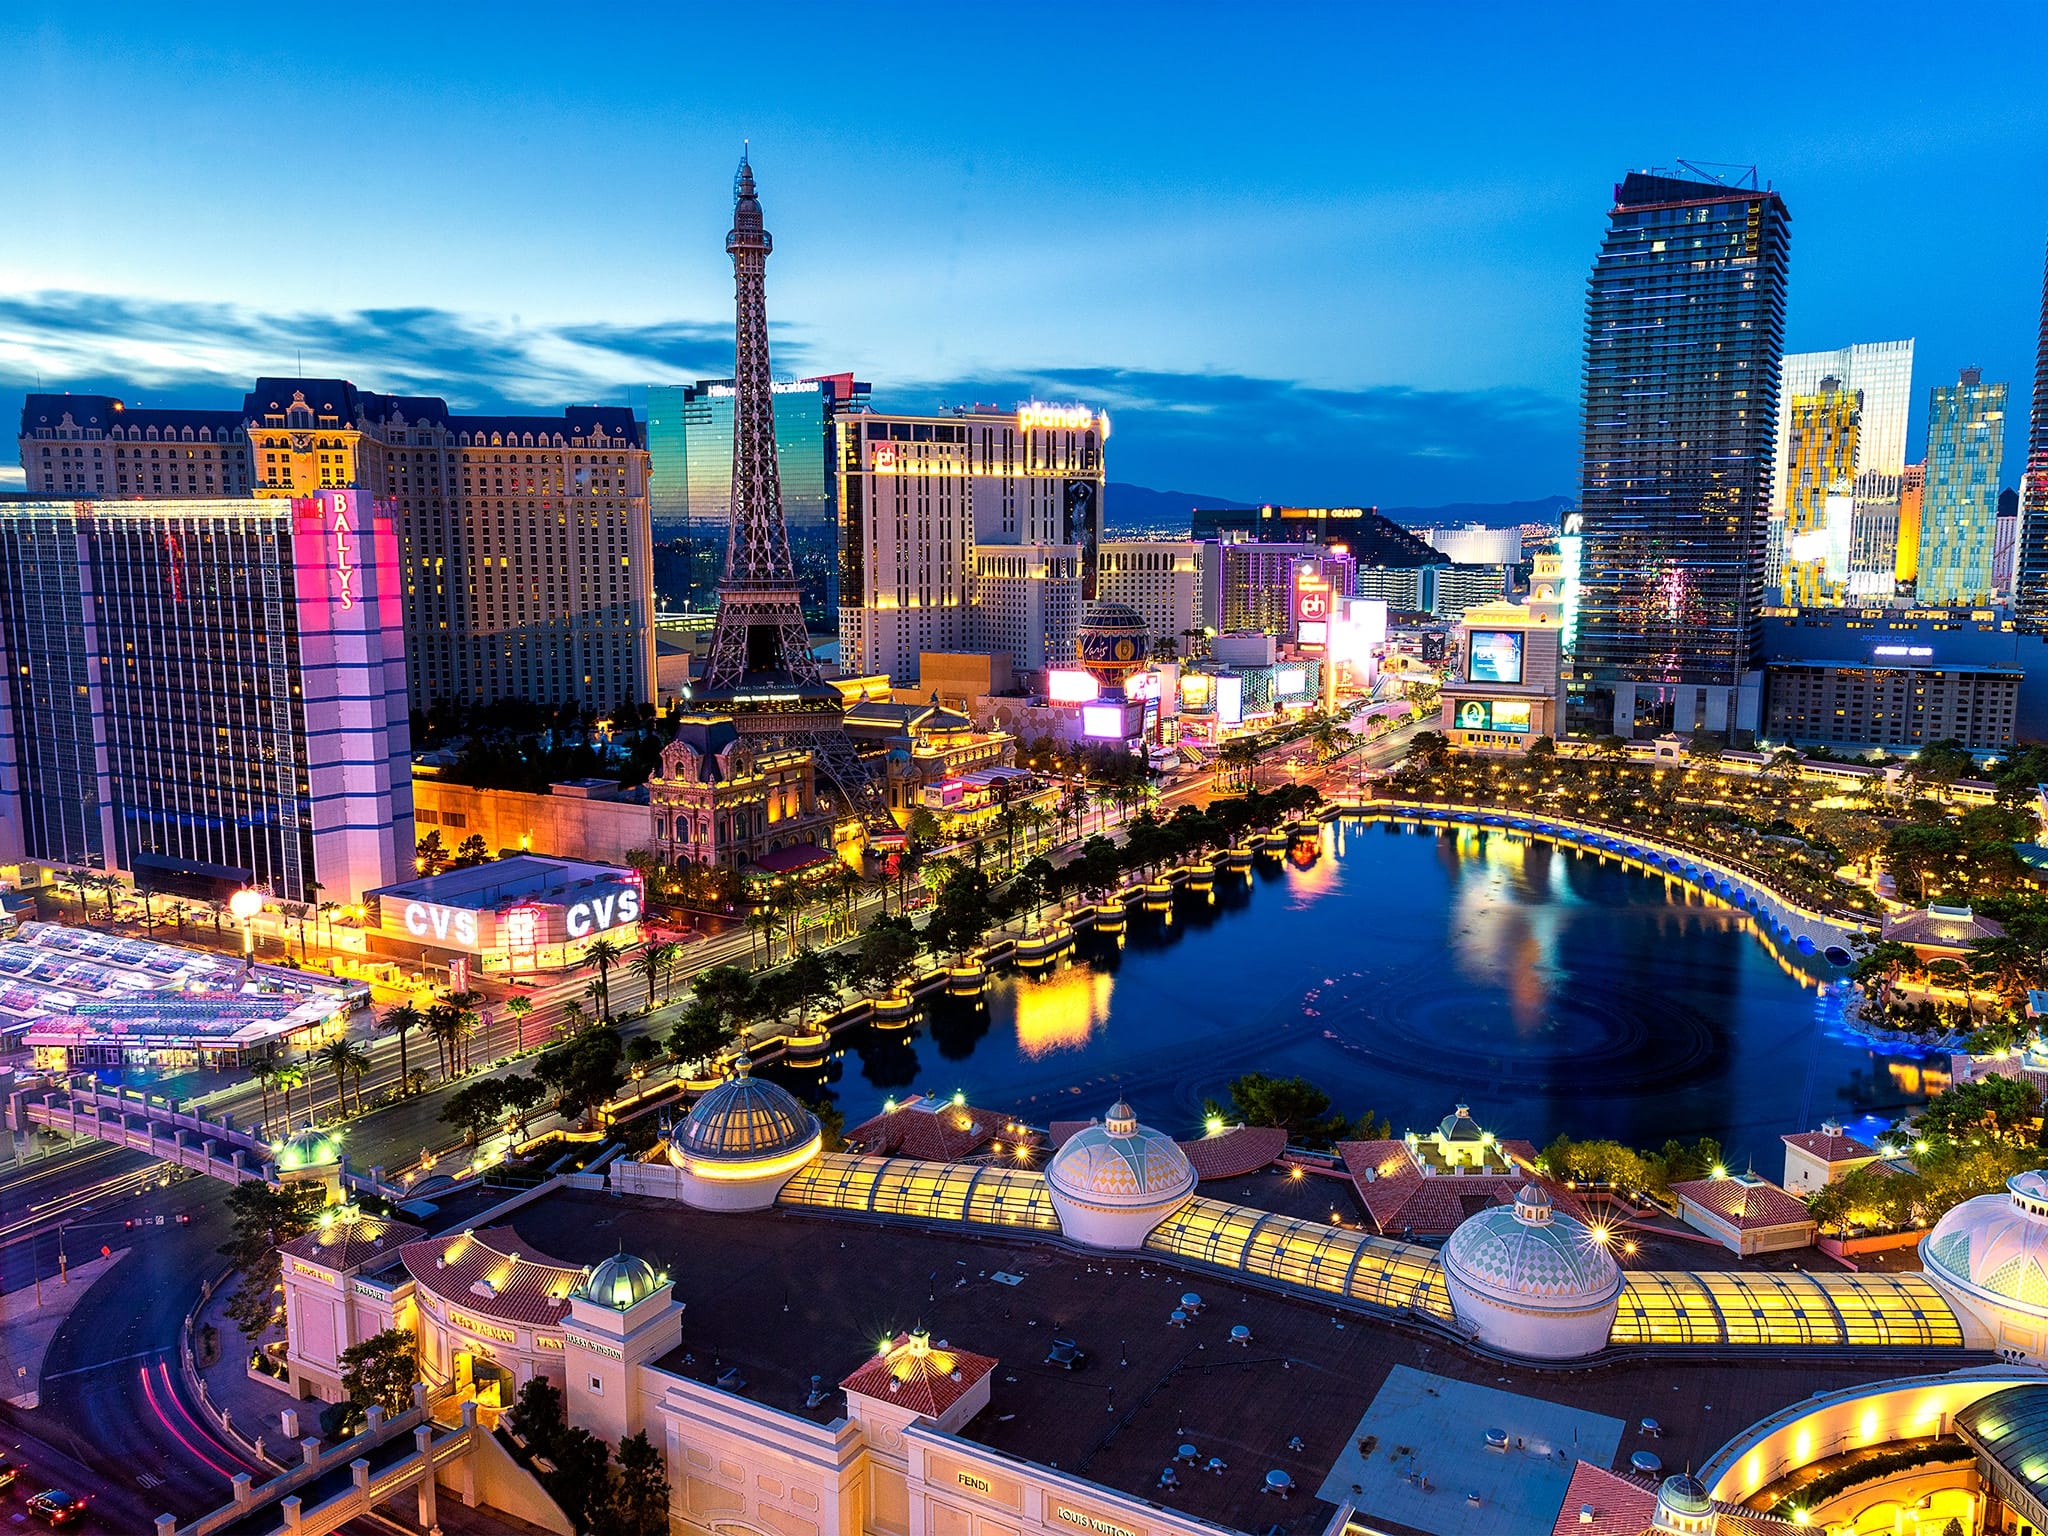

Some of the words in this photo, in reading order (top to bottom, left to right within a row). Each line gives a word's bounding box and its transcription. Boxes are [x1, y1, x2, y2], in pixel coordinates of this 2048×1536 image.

[770, 381, 819, 395] Vacations
[1019, 402, 1093, 432] planet
[1330, 508, 1363, 519] GRAND
[405, 903, 477, 945] CVS
[567, 889, 639, 938] CVS
[565, 1333, 588, 1348] HARRY
[588, 1339, 623, 1359] WINSTON
[958, 1474, 989, 1492] FENDI
[1058, 1507, 1088, 1527] LOUIS
